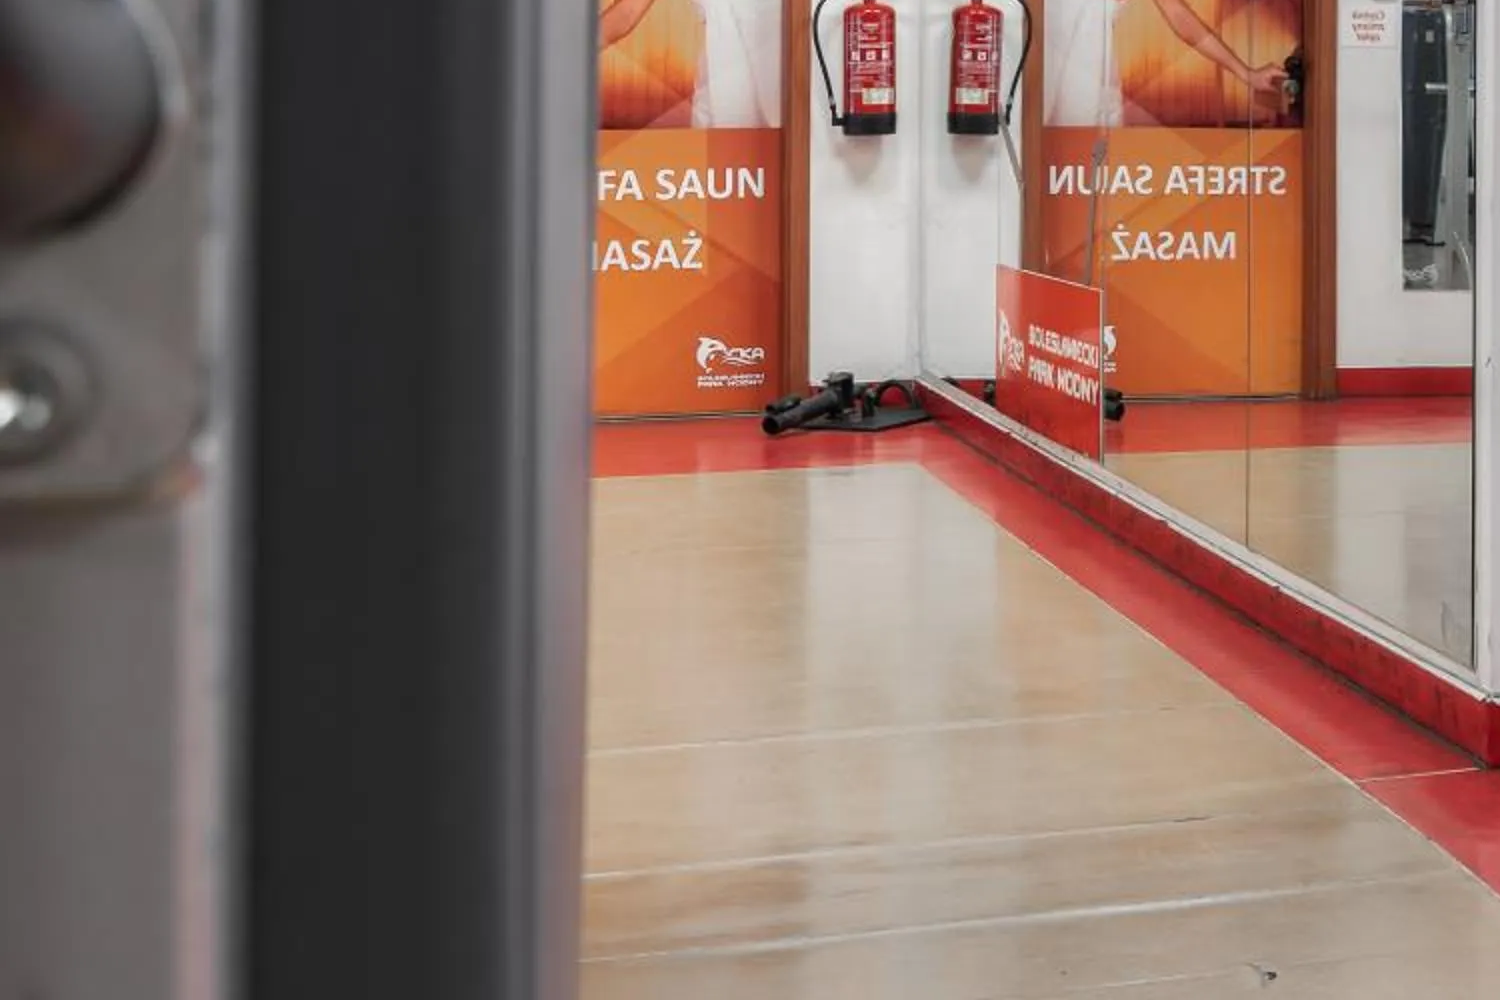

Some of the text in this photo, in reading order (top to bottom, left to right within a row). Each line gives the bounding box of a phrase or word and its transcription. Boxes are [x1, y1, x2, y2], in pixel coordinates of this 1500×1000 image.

[655, 167, 765, 200] SAUN
[591, 230, 704, 271] ASAŻ
[1027, 355, 1099, 406] PARK WODNY
